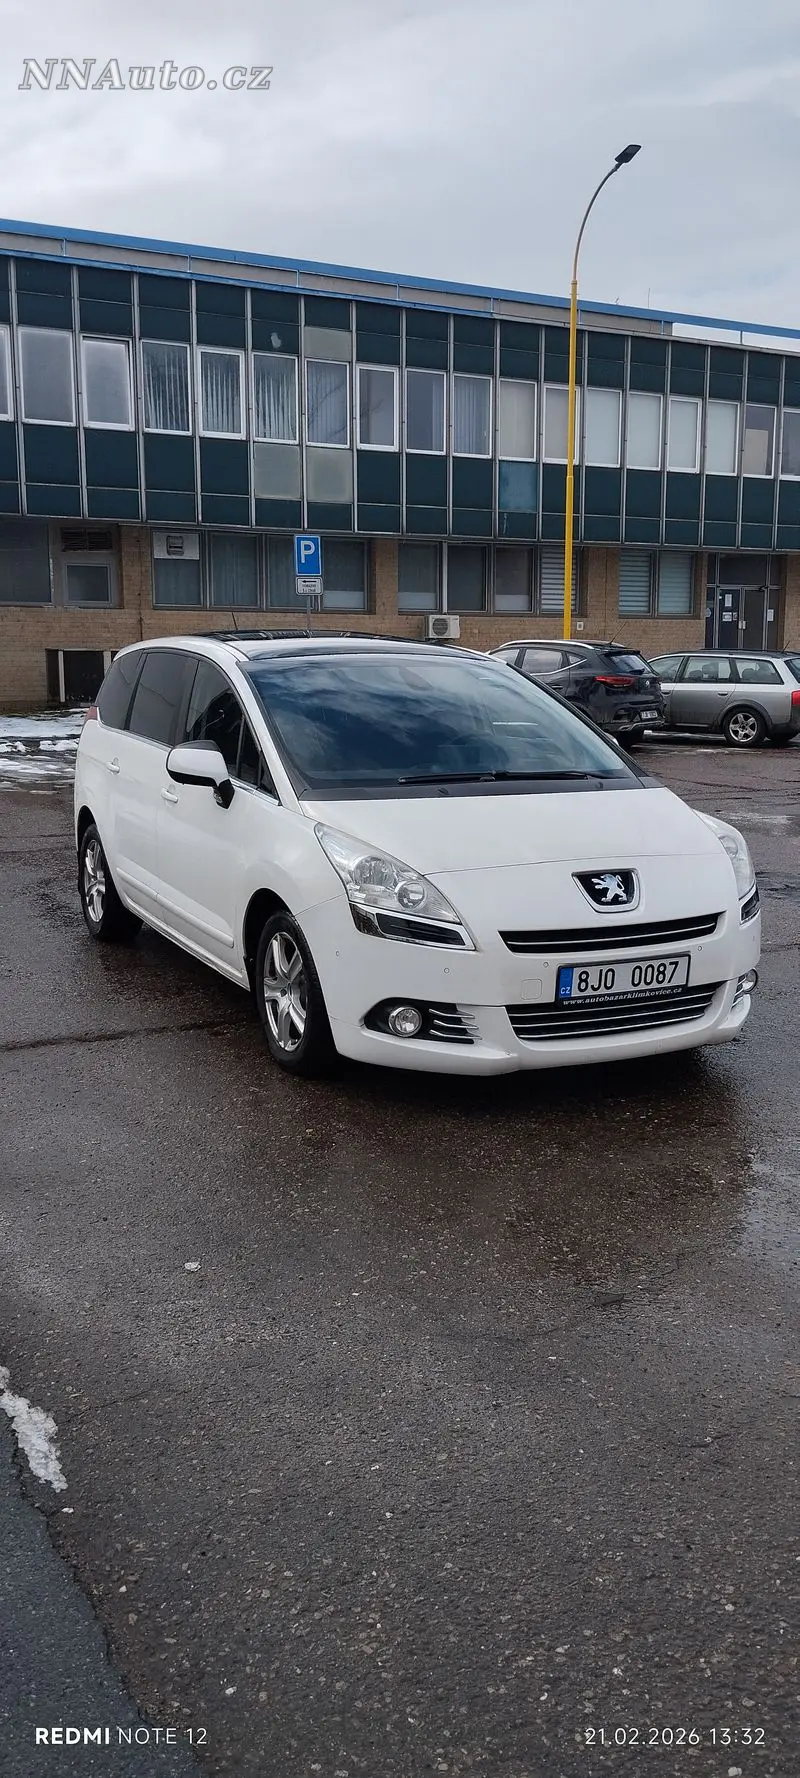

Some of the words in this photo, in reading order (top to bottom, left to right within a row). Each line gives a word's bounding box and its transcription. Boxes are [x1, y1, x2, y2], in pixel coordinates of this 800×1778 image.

[300, 540, 316, 564] P
[577, 967, 616, 993] 8J0
[631, 960, 680, 988] 0087
[563, 987, 683, 1006] www.autobazarklimkovice.cz
